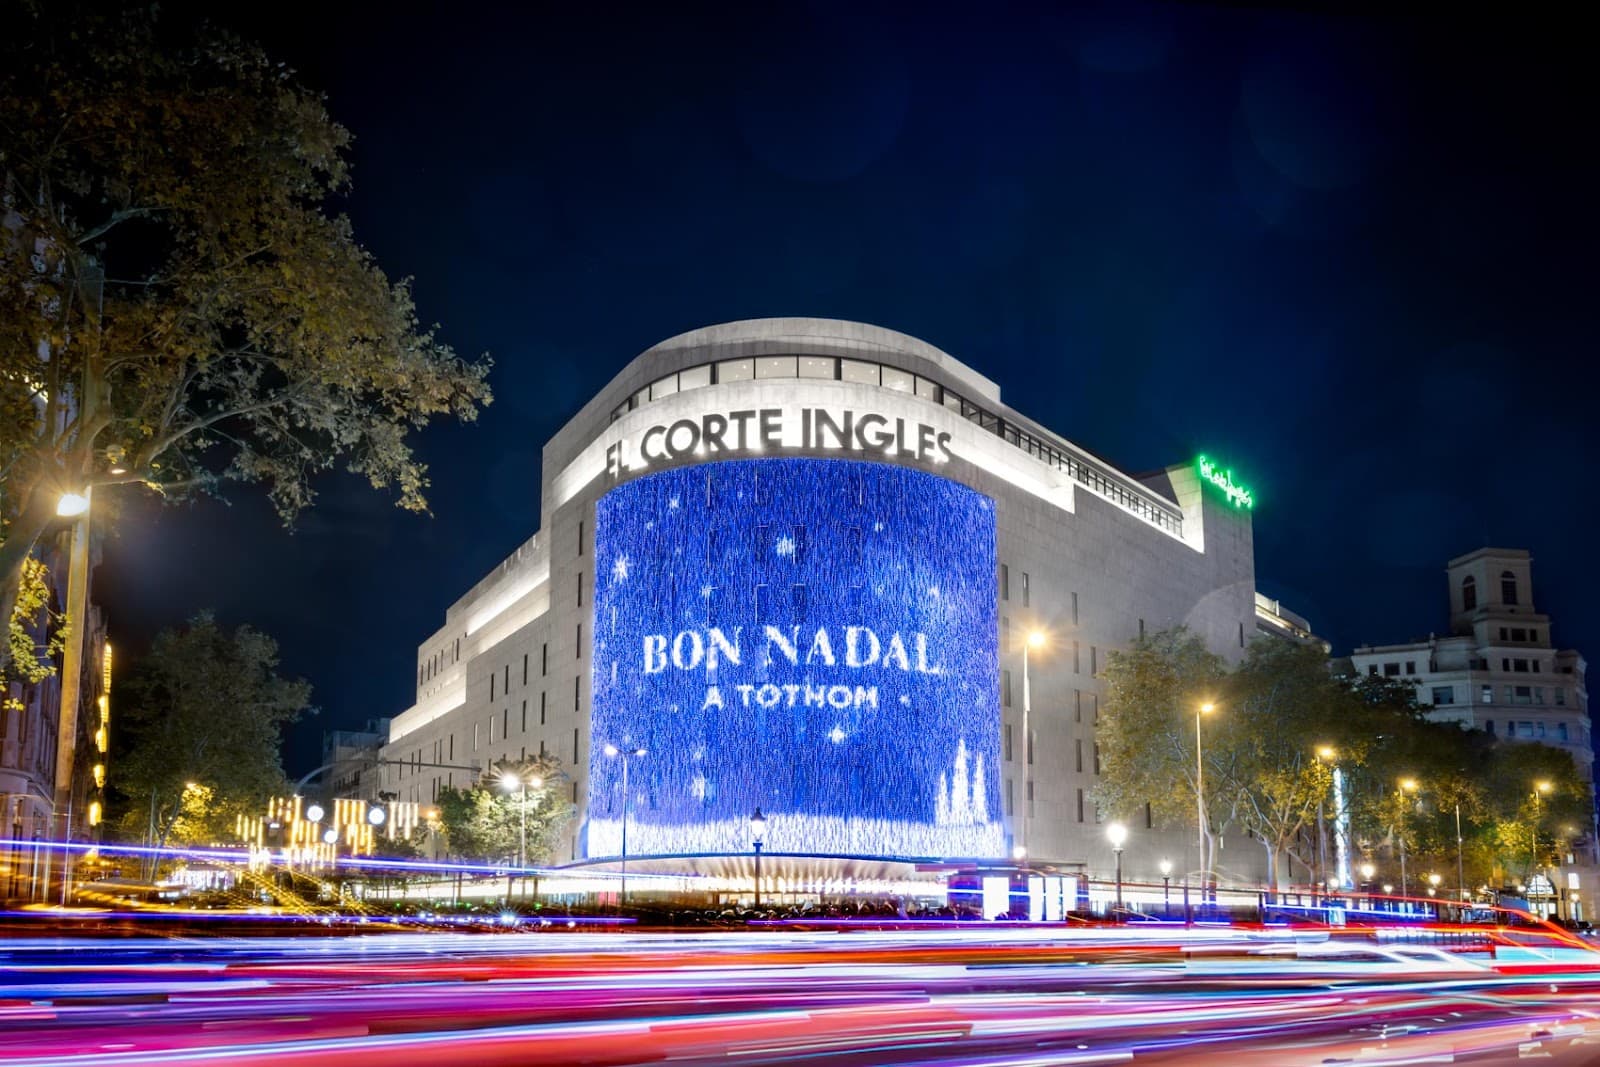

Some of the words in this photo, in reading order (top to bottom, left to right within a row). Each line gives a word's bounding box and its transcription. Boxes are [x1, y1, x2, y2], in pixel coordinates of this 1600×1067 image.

[607, 440, 631, 475] EL
[641, 409, 783, 462] CORTE
[802, 408, 953, 463] INGLES
[644, 627, 742, 674] BON
[764, 626, 940, 675] NADAL
[704, 687, 724, 710] A
[738, 683, 878, 708] TOTHOM
